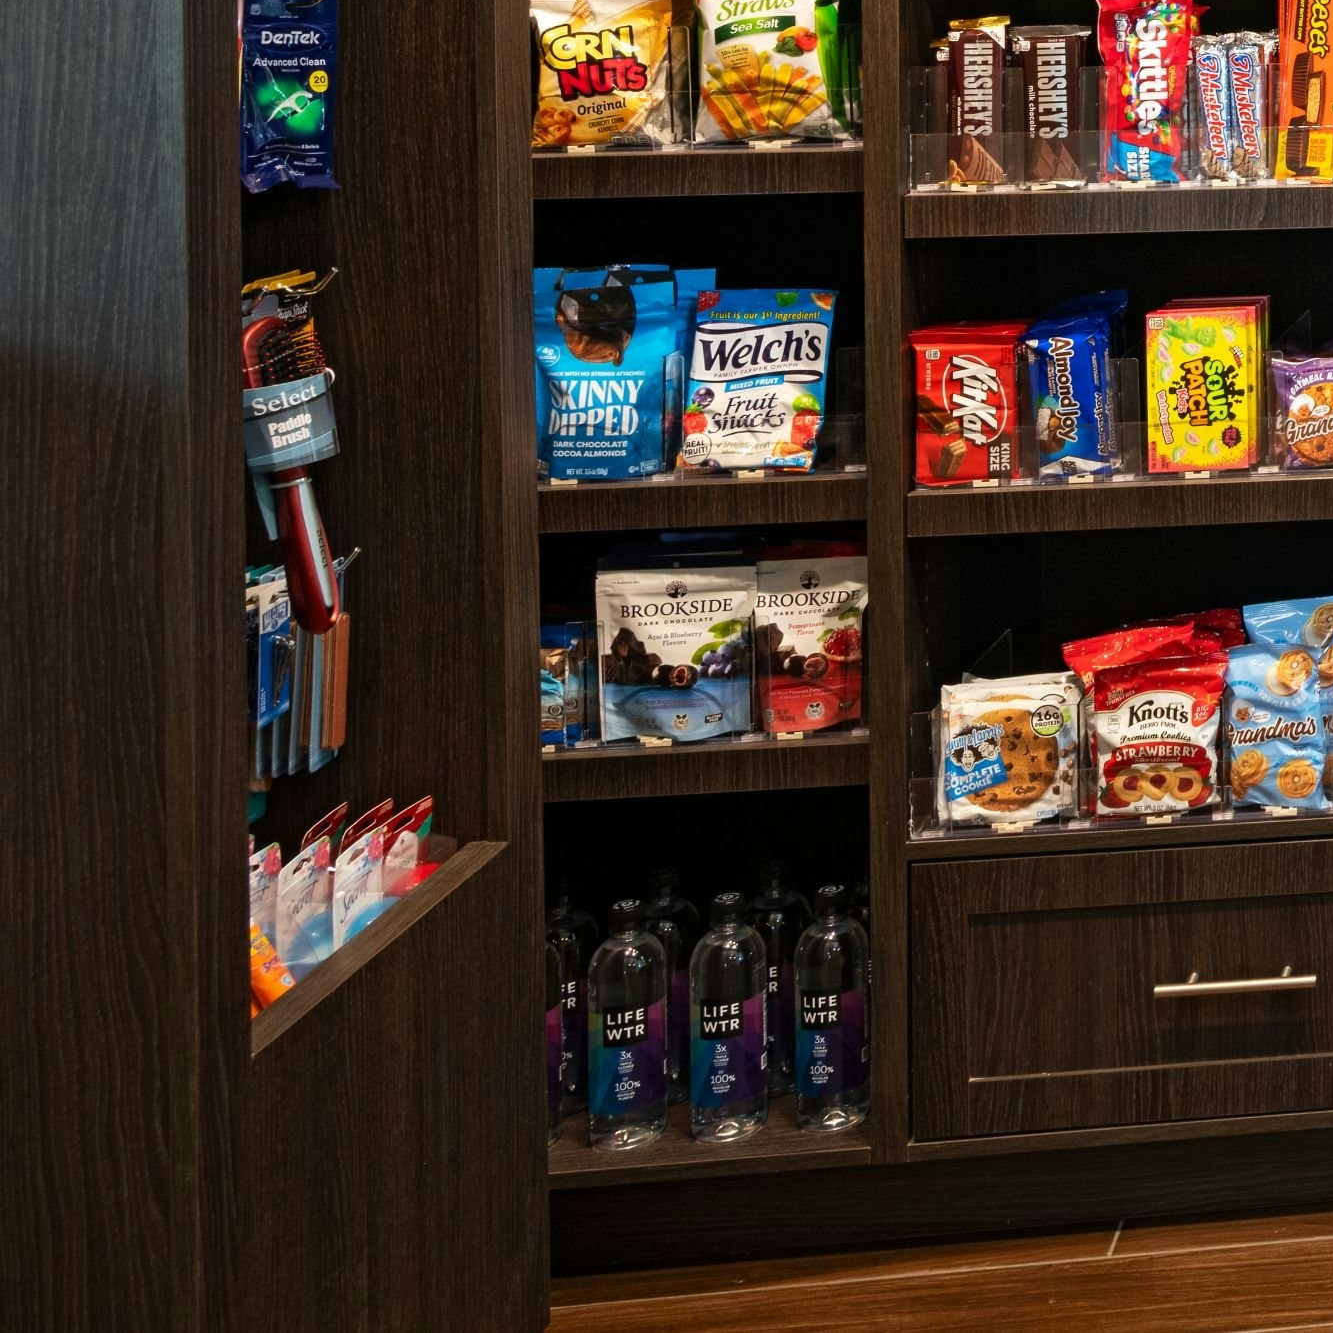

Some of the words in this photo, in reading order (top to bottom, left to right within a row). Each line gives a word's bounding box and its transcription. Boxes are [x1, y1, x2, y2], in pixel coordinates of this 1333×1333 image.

[730, 22, 753, 34] Sea
[755, 18, 779, 30] Salt
[261, 30, 320, 45] DenTek
[541, 24, 634, 70] CORN
[253, 57, 298, 67] Advanced
[300, 57, 326, 66] Clean
[314, 76, 326, 84] 20
[561, 57, 648, 101] NUTS
[1136, 19, 1169, 137] Skittles
[963, 42, 993, 137] HERSHEY'S
[1037, 42, 1068, 139] HERSHEY'S
[577, 98, 627, 116] Original
[1309, 138, 1318, 163] SIZE
[1318, 138, 1327, 163] KING
[699, 329, 822, 372] Welch's
[730, 379, 755, 390] MIXED
[757, 377, 779, 386] FRUIT
[1181, 360, 1208, 425] PATCH
[1205, 360, 1228, 420] SOUR
[252, 385, 318, 416] Select
[549, 380, 644, 410] SKINNY
[724, 393, 778, 416] Fruit
[268, 413, 312, 436] Paddle
[271, 429, 311, 449] Brush
[686, 440, 705, 449] REAL
[988, 445, 999, 471] SIZE
[999, 442, 1010, 471] KING
[620, 598, 733, 618] BROOKSIDE
[757, 589, 861, 608] BROOKSIDE
[664, 617, 714, 625] CHOCOLATE
[1128, 700, 1189, 727] Knott's
[1115, 746, 1198, 761] STRAWBERRY
[703, 1002, 740, 1018] LIFE
[803, 995, 838, 1008] LIFE
[606, 1008, 645, 1026] LIFE
[703, 1018, 740, 1034] WTR
[803, 1010, 838, 1024] WTR
[606, 1024, 645, 1041] WTR
